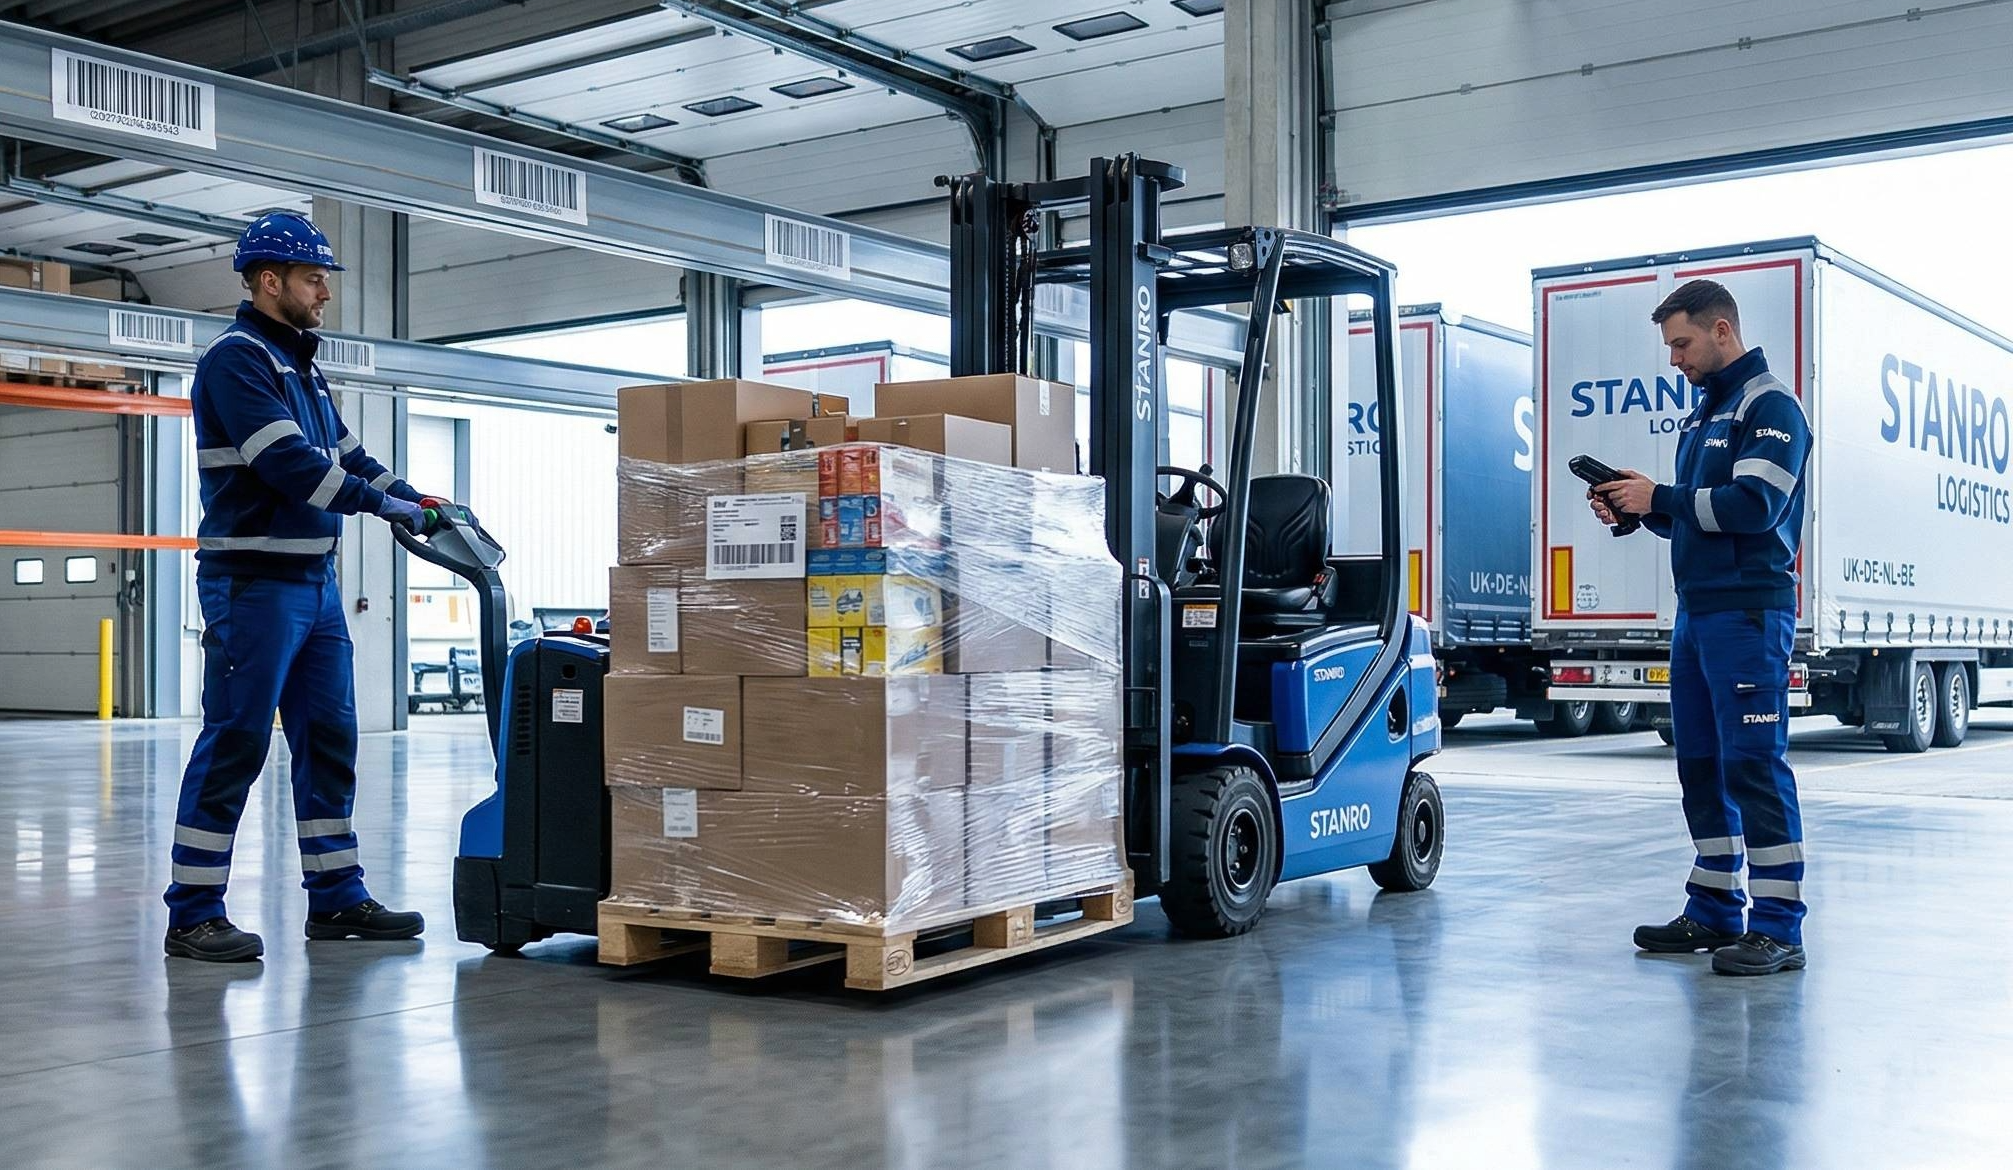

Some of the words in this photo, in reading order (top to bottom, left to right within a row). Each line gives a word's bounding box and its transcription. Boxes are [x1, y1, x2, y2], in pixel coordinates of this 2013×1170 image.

[1135, 285, 1152, 422] STANRO
[1880, 353, 2010, 475] STANRO
[1937, 473, 2010, 524] LOGISTICS
[1310, 803, 1371, 839] STANRO
